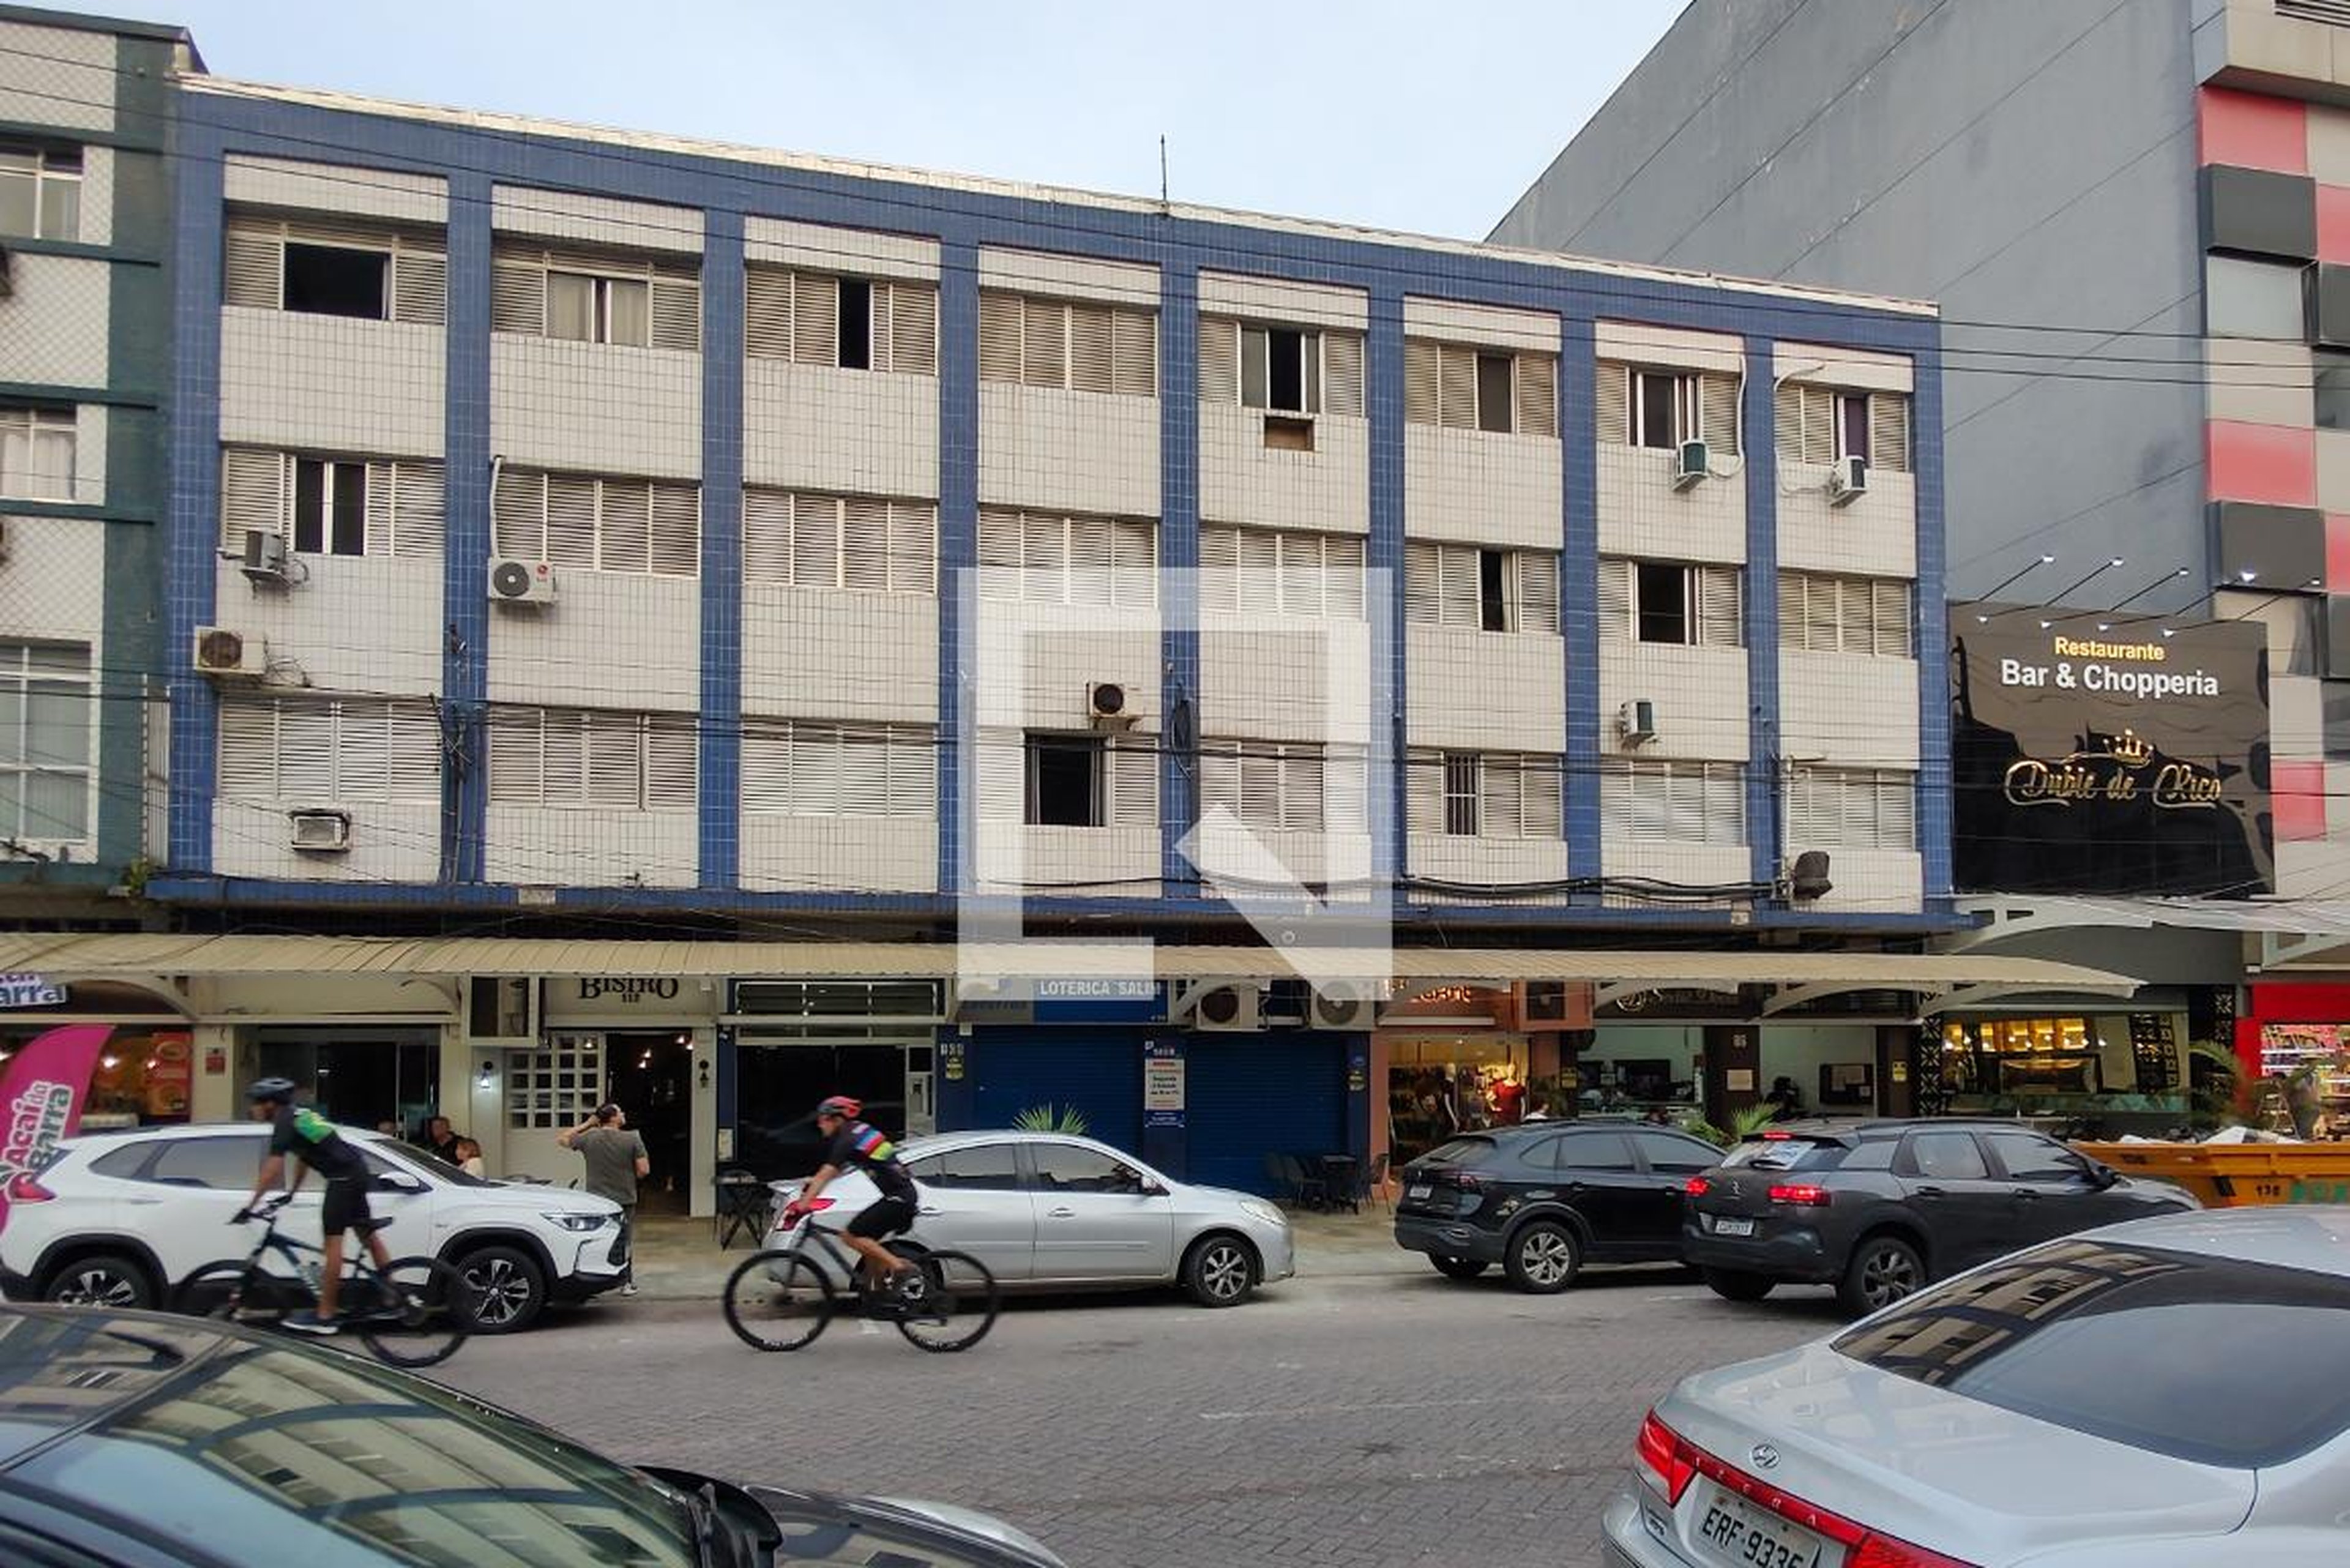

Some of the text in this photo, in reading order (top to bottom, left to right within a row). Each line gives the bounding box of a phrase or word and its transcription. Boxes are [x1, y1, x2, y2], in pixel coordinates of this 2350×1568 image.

[2055, 637, 2165, 661] Restaurante
[2001, 659, 2218, 699] Bar & Chopperia
[2107, 767, 2137, 799] de
